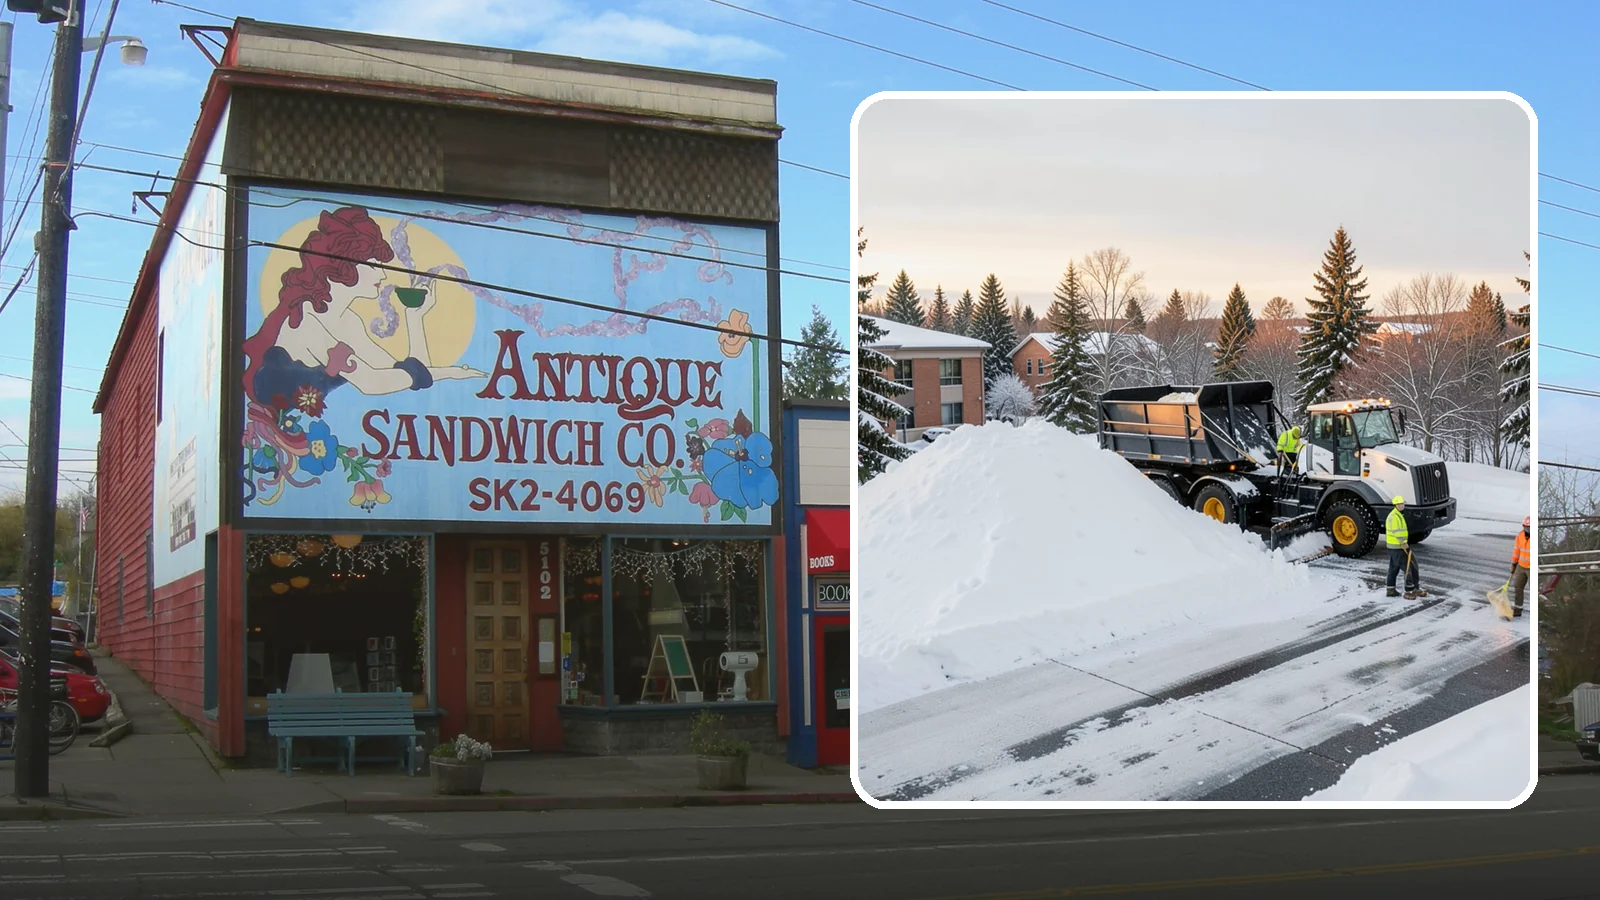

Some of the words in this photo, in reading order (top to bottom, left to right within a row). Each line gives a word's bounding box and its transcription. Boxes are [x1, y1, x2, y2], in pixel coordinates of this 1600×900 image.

[475, 329, 723, 420] ANTIQUE
[361, 409, 604, 468] SANDWICH
[618, 421, 685, 469] CO.
[468, 477, 645, 512] SK2-4069
[539, 542, 551, 599] 5102
[809, 555, 835, 568] BOOKS
